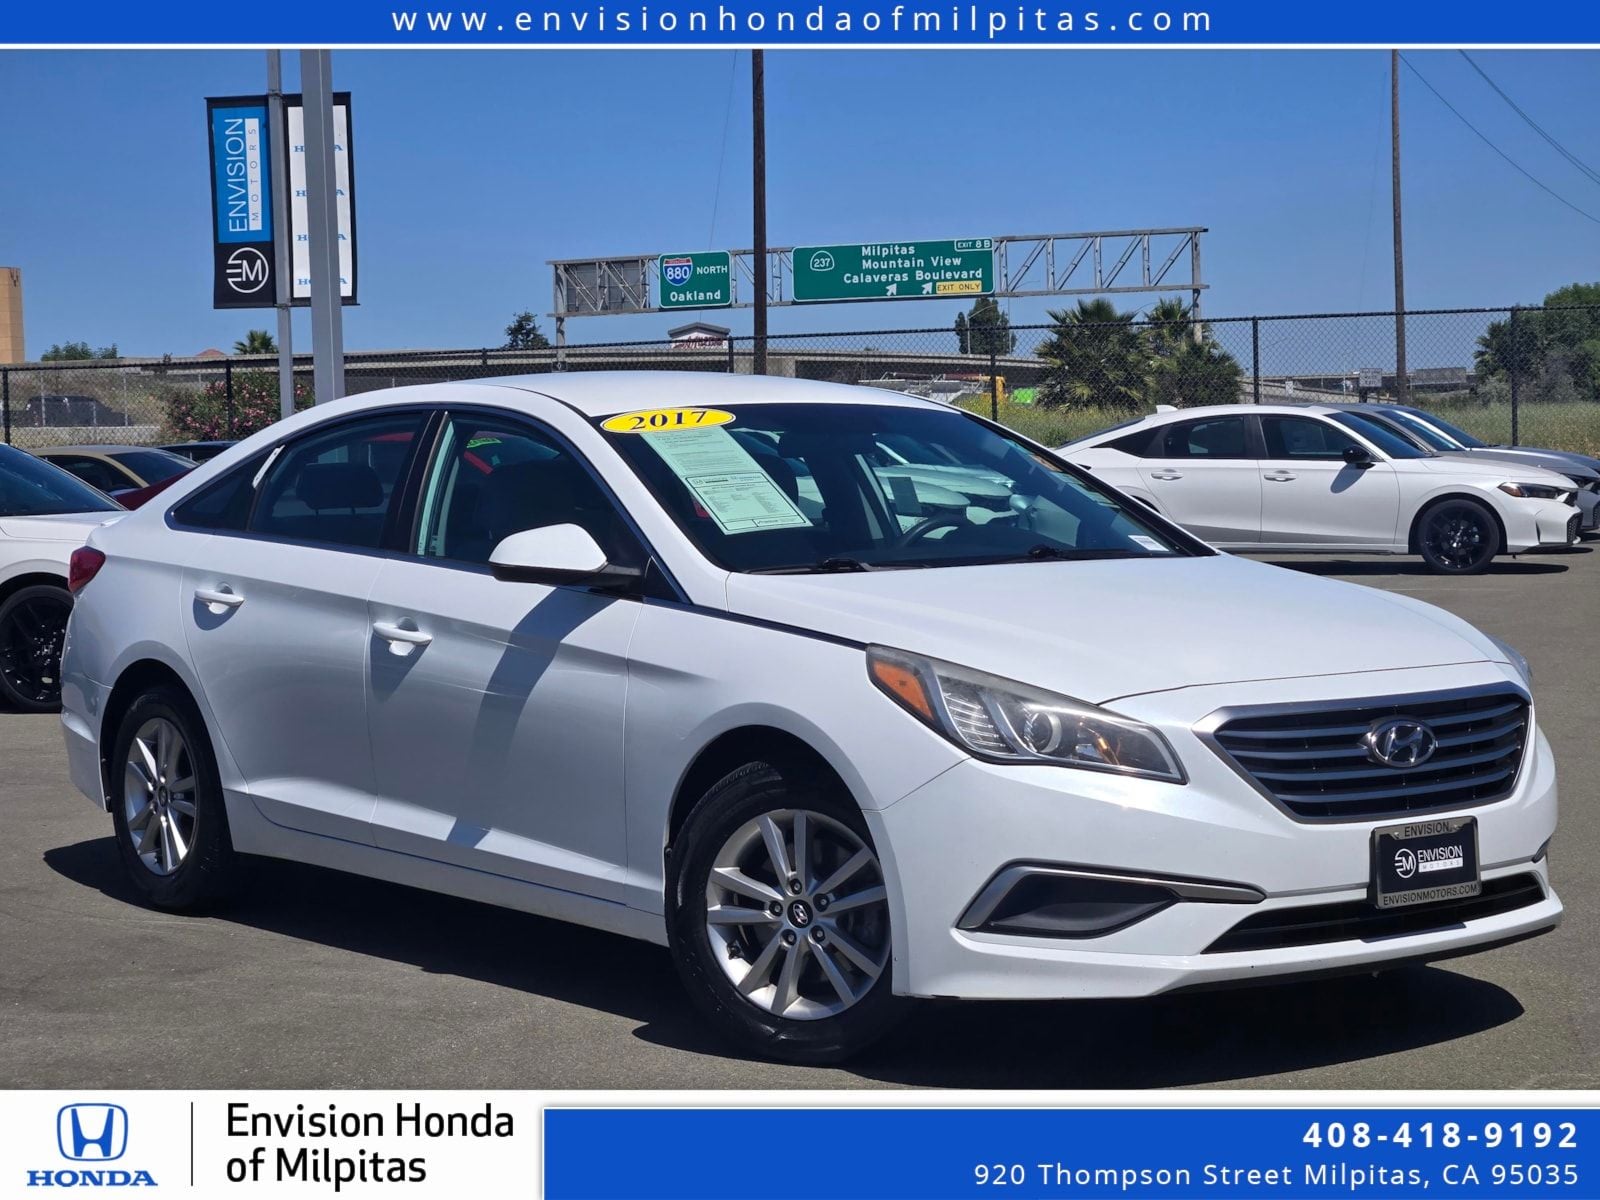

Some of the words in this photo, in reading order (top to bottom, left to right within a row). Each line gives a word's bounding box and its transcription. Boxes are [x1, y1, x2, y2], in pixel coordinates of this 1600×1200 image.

[225, 118, 248, 232] ENVISION
[248, 128, 260, 222] MOTORS
[861, 245, 916, 258] Milpitas
[814, 258, 831, 267] 237
[862, 258, 924, 270] Mountain
[931, 256, 962, 267] View
[667, 266, 690, 280] 880
[696, 265, 728, 275] NORTH
[843, 272, 909, 284] Calaveras
[915, 268, 983, 281] Boulevard
[937, 283, 955, 292] EXIT
[959, 281, 981, 290] ONLY
[670, 290, 721, 302] Oakland
[631, 411, 706, 429] 2017
[1405, 822, 1449, 837] ENVISION
[1417, 845, 1463, 862] ENVISION
[1383, 884, 1478, 906] ENVISIONMOTORS.COM
